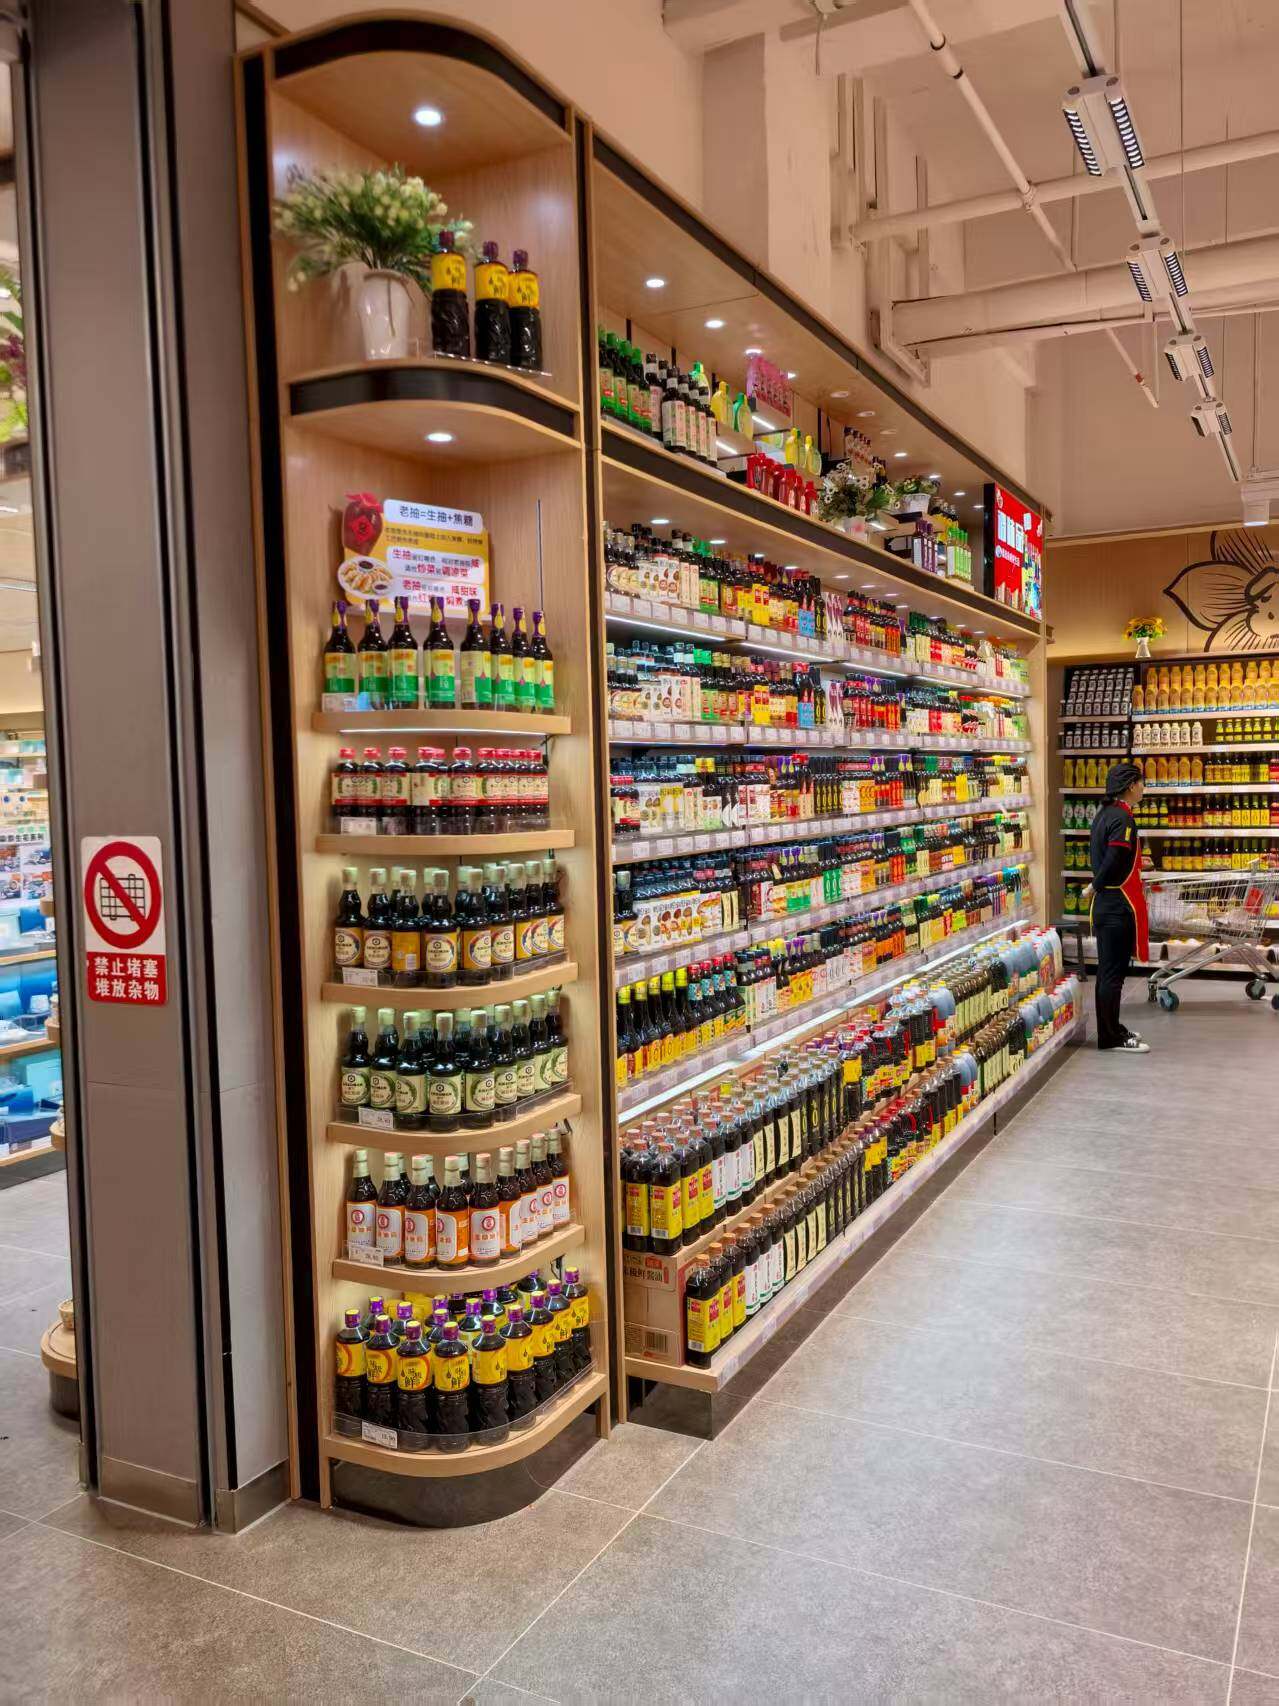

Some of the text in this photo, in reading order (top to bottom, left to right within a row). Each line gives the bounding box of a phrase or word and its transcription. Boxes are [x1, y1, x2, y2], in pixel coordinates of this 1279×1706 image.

[94, 956, 159, 979] 禁止堵塞
[95, 977, 160, 1001] 堆放杂物
